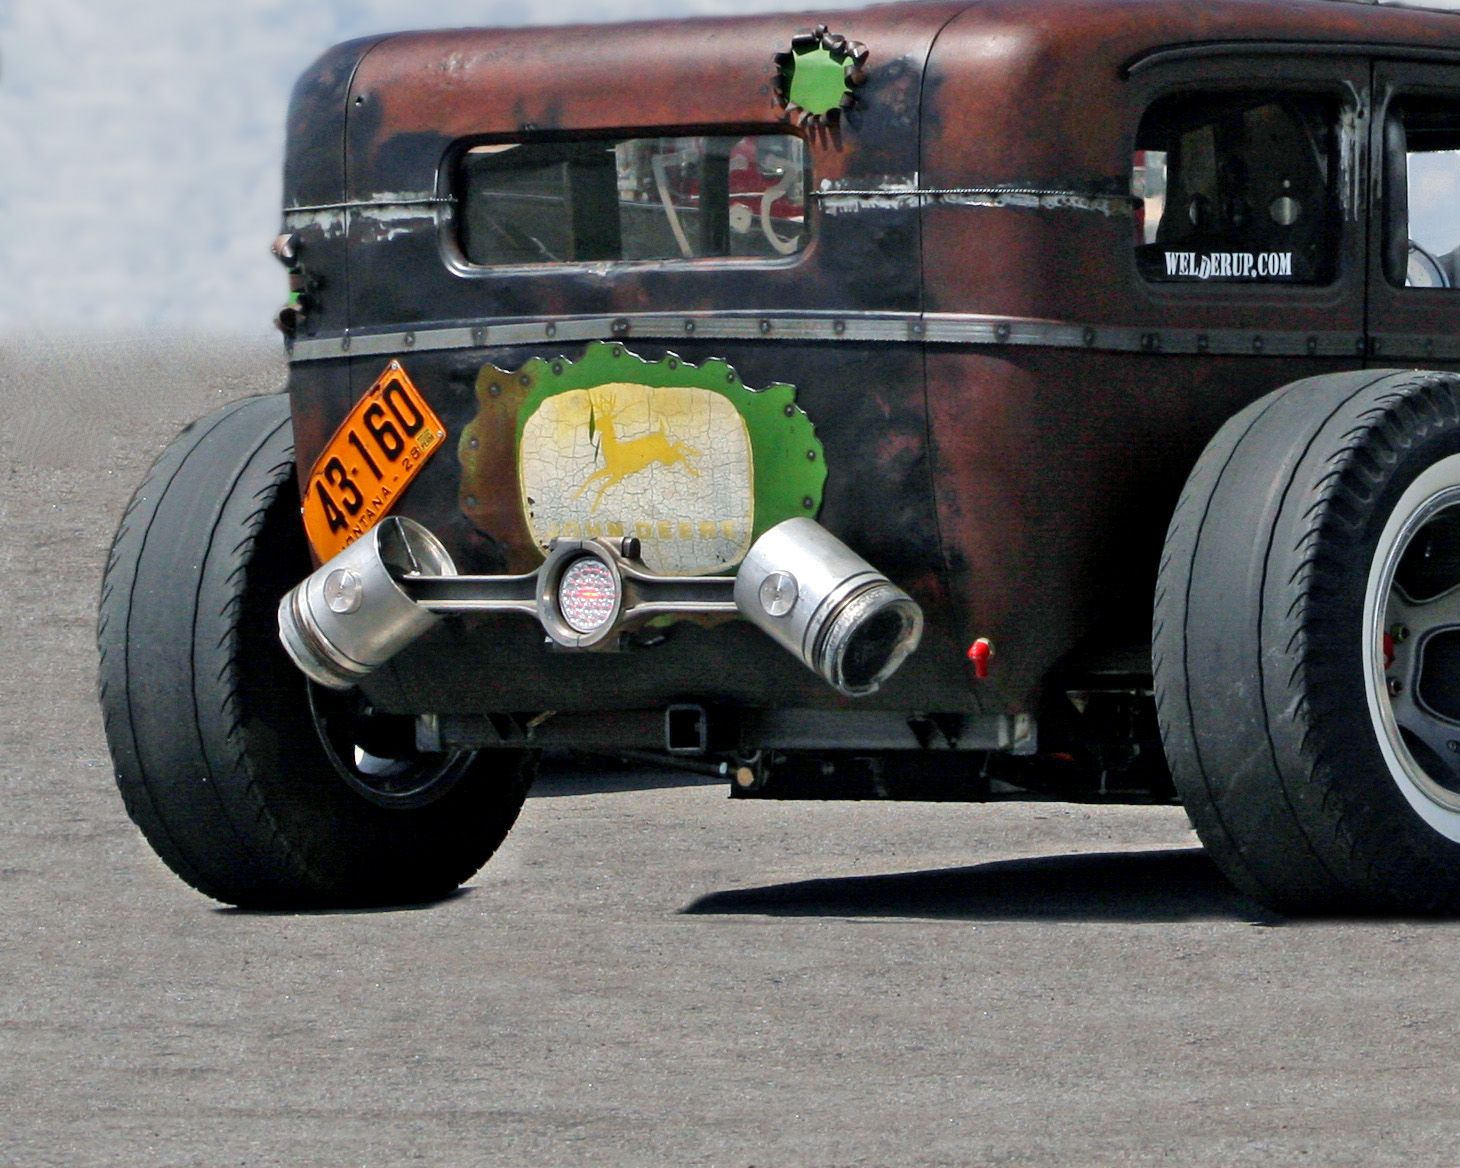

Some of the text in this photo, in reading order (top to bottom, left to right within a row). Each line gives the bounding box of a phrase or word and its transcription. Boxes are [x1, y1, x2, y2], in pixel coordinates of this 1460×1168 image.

[1164, 251, 1292, 279] WELDERUP.COM
[315, 378, 424, 535] 43-160
[341, 486, 392, 550] ONTANA
[634, 520, 737, 540] DEERE
